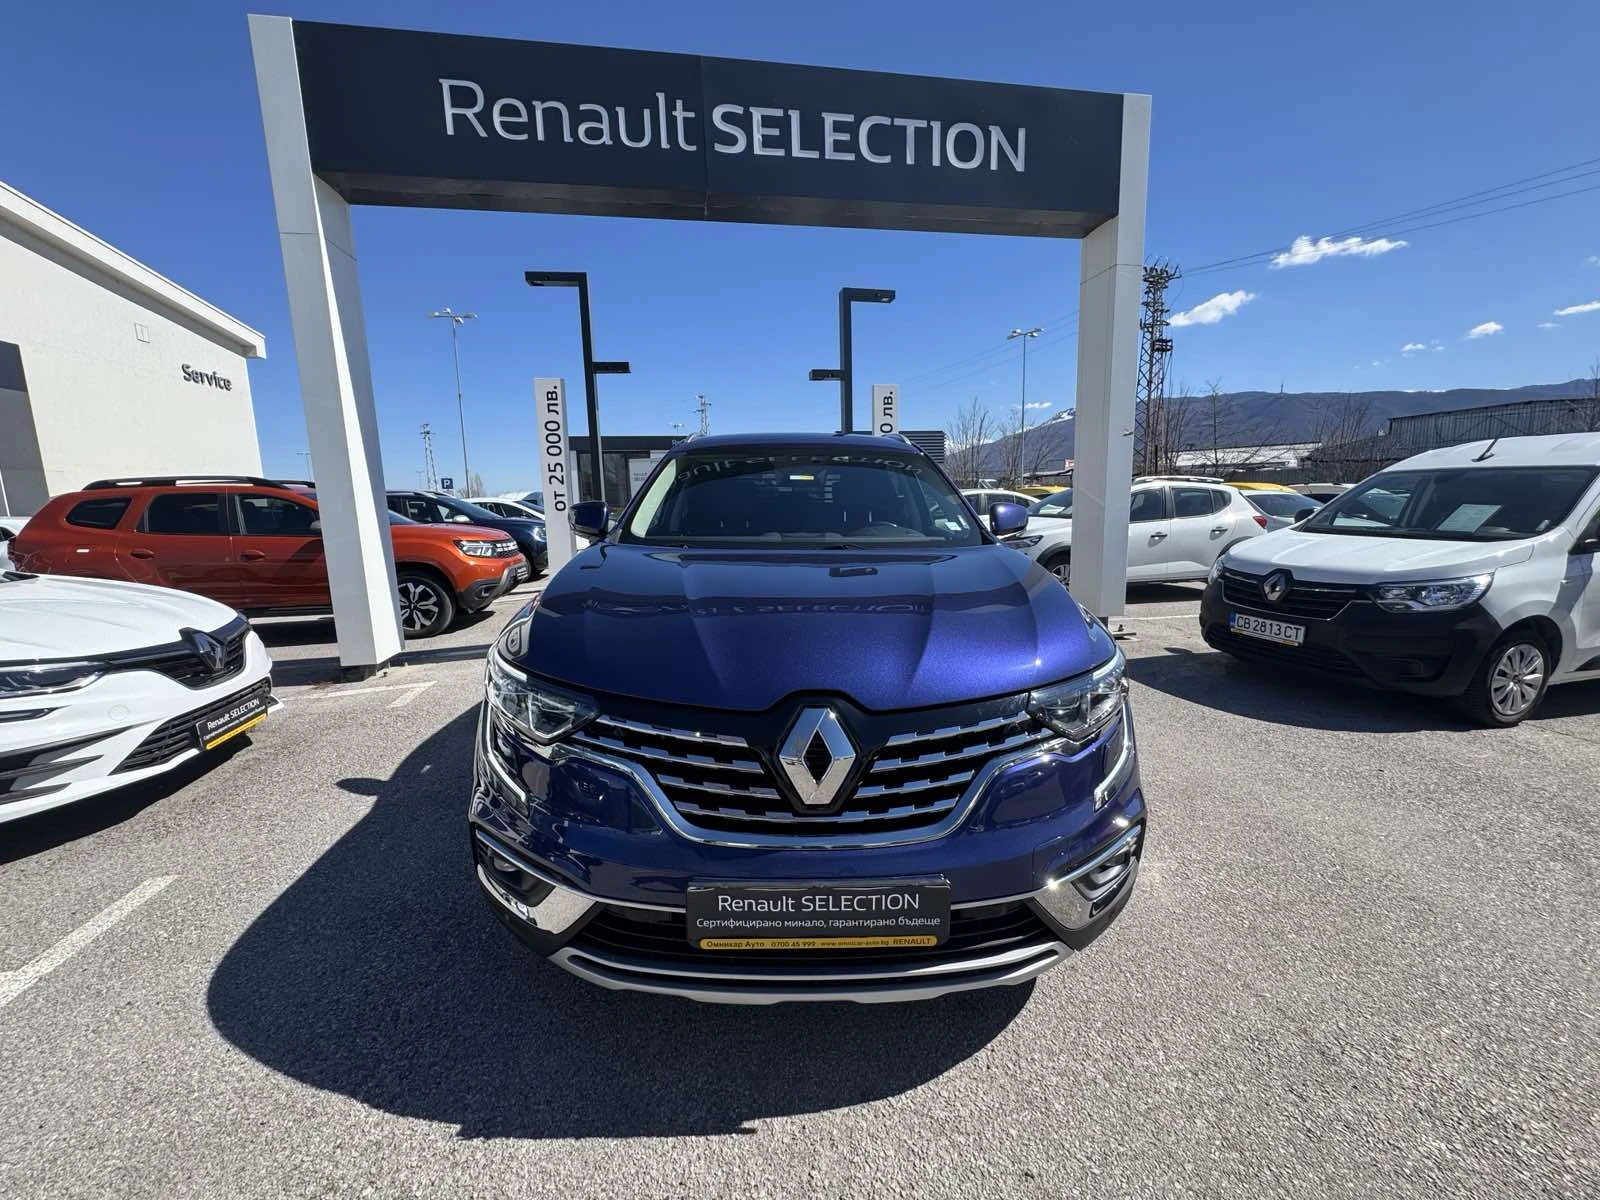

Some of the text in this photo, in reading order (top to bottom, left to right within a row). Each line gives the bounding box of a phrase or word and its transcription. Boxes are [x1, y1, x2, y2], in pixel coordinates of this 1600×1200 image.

[438, 78, 1027, 172] Renault SELECTION
[181, 363, 232, 391] Service
[883, 391, 893, 418] лв.
[544, 385, 567, 512] от 25 000 лв.
[1253, 620, 1281, 636] 2813
[206, 713, 230, 731] Renault
[230, 698, 260, 719] SELECTION
[717, 893, 919, 912] Renault SELECTION
[696, 916, 941, 929] Сертифицирано минало, гарантирано бъдеще
